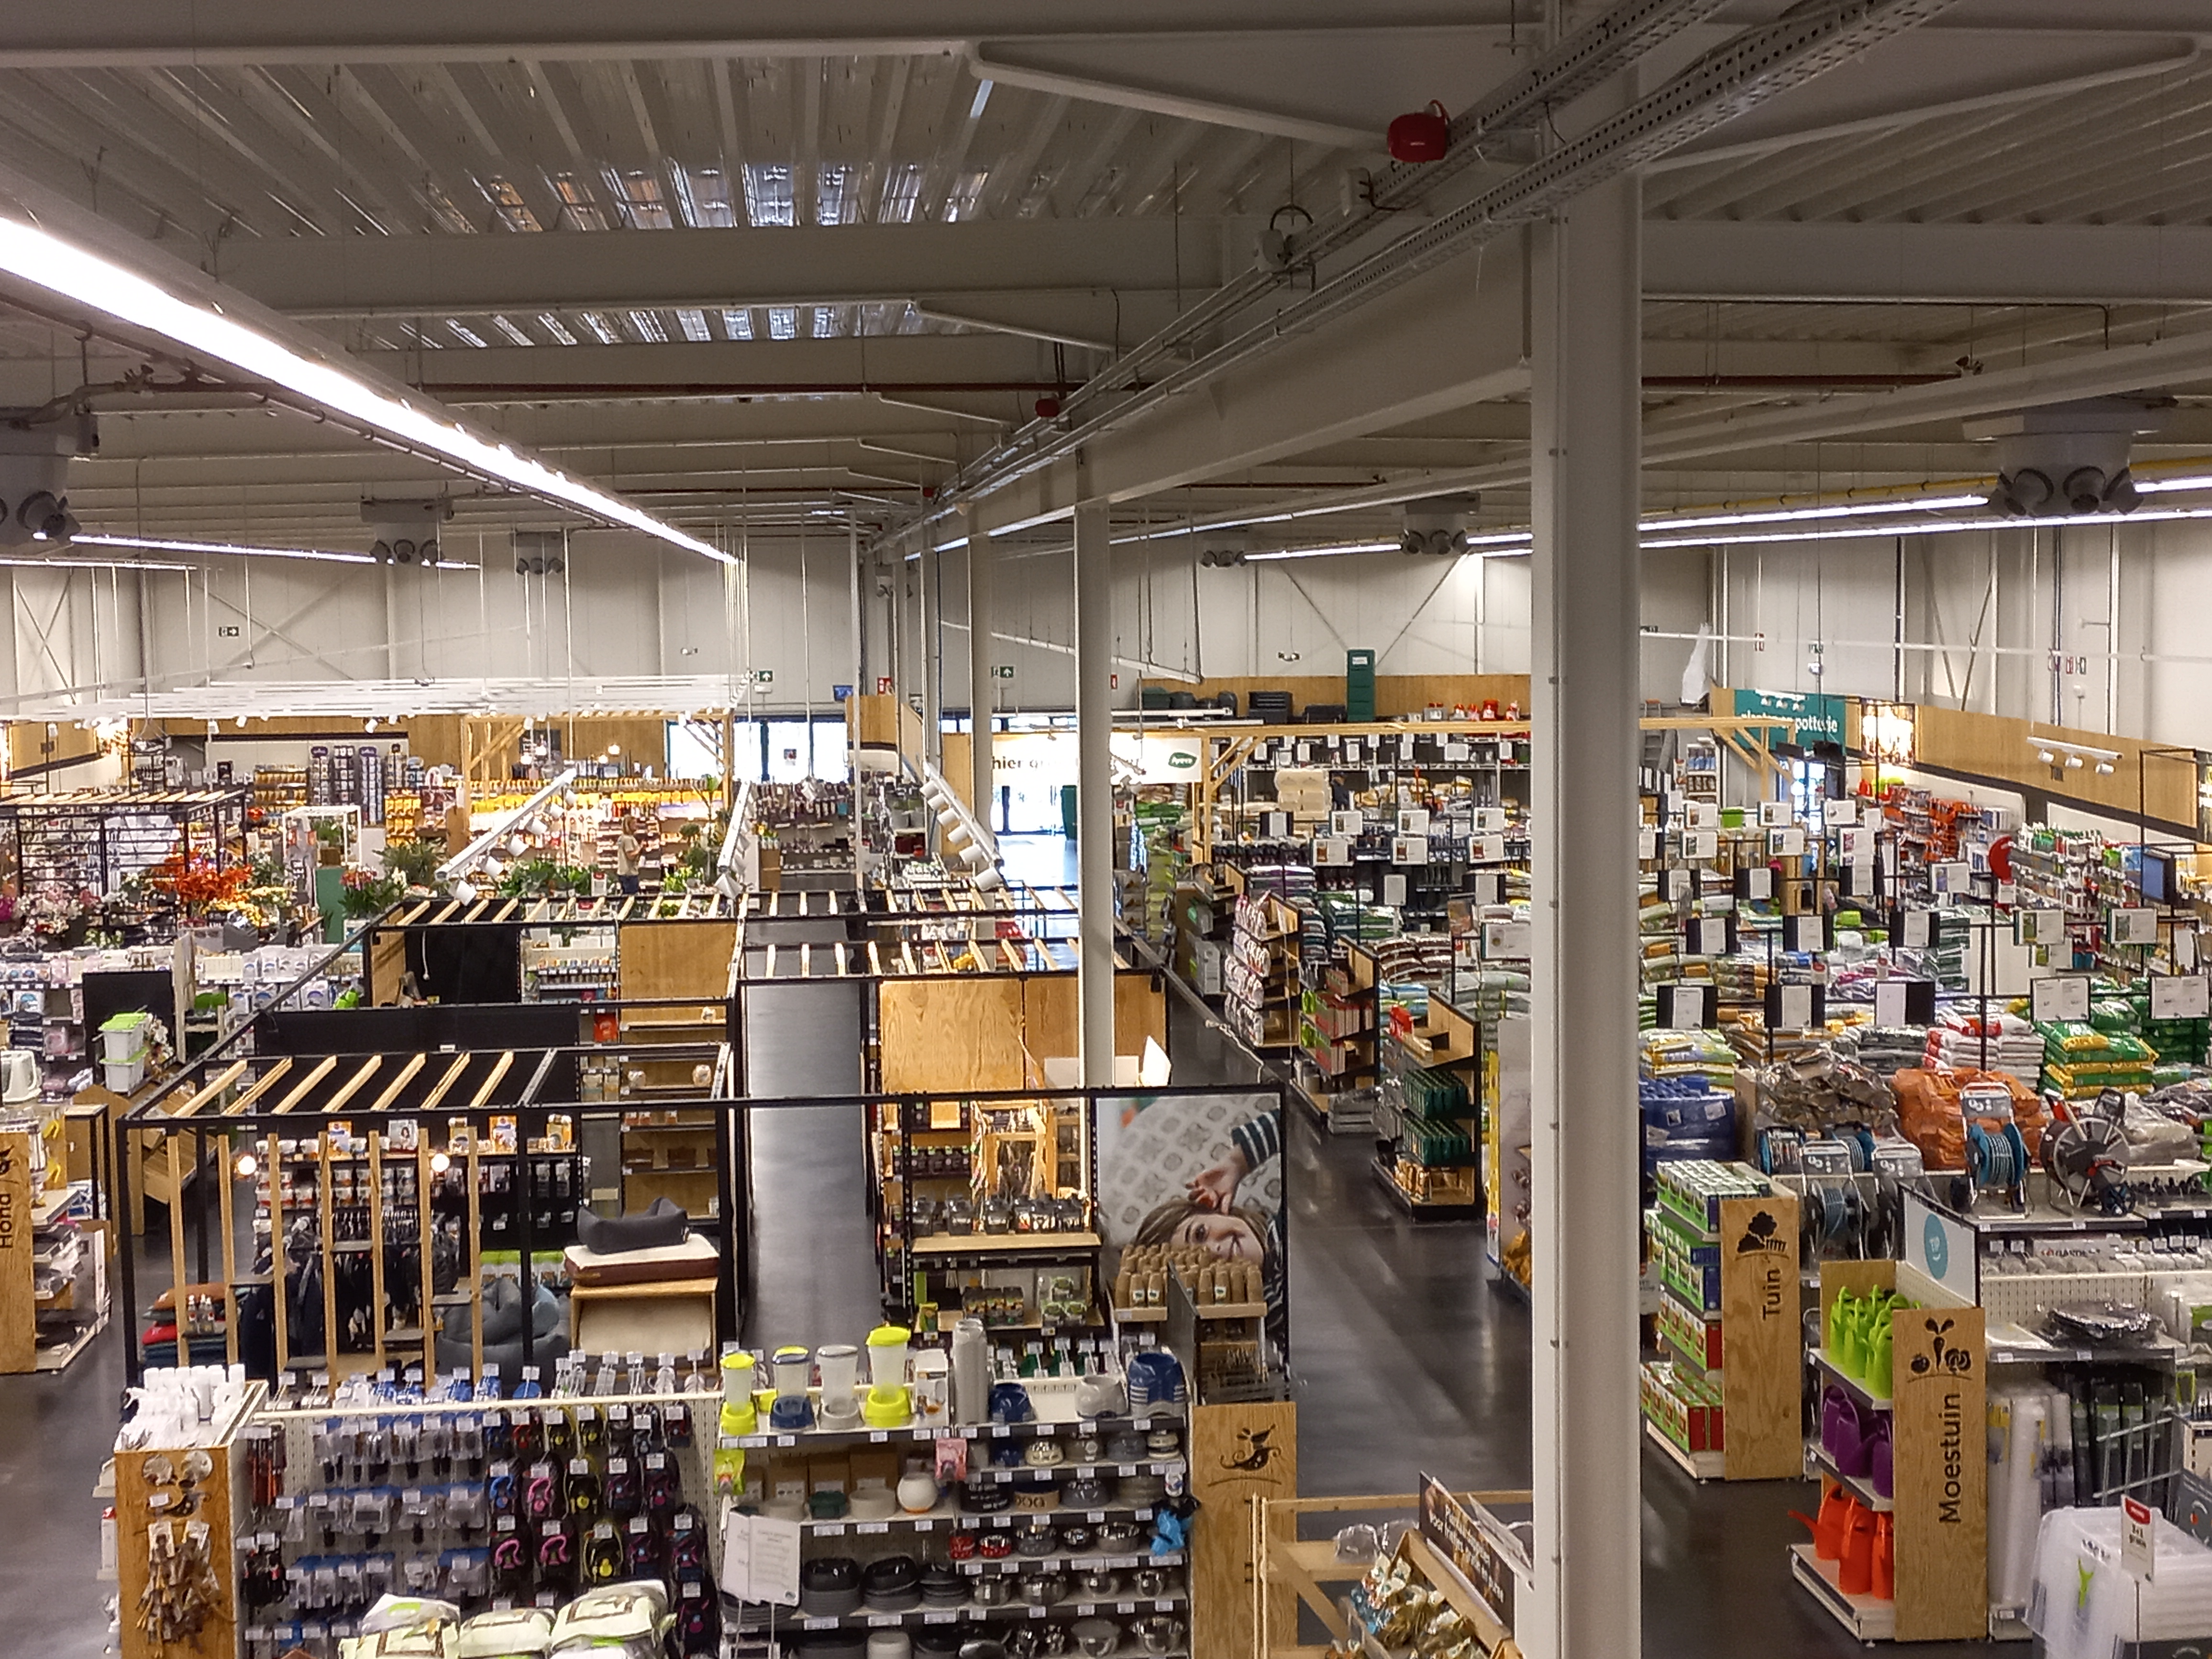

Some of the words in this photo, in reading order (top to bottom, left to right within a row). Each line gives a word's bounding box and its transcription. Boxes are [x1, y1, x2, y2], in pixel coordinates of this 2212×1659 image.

[1795, 715, 1837, 733] potteie
[1763, 1269, 1780, 1321] Tuin
[1938, 1393, 1961, 1523] Moestuin
